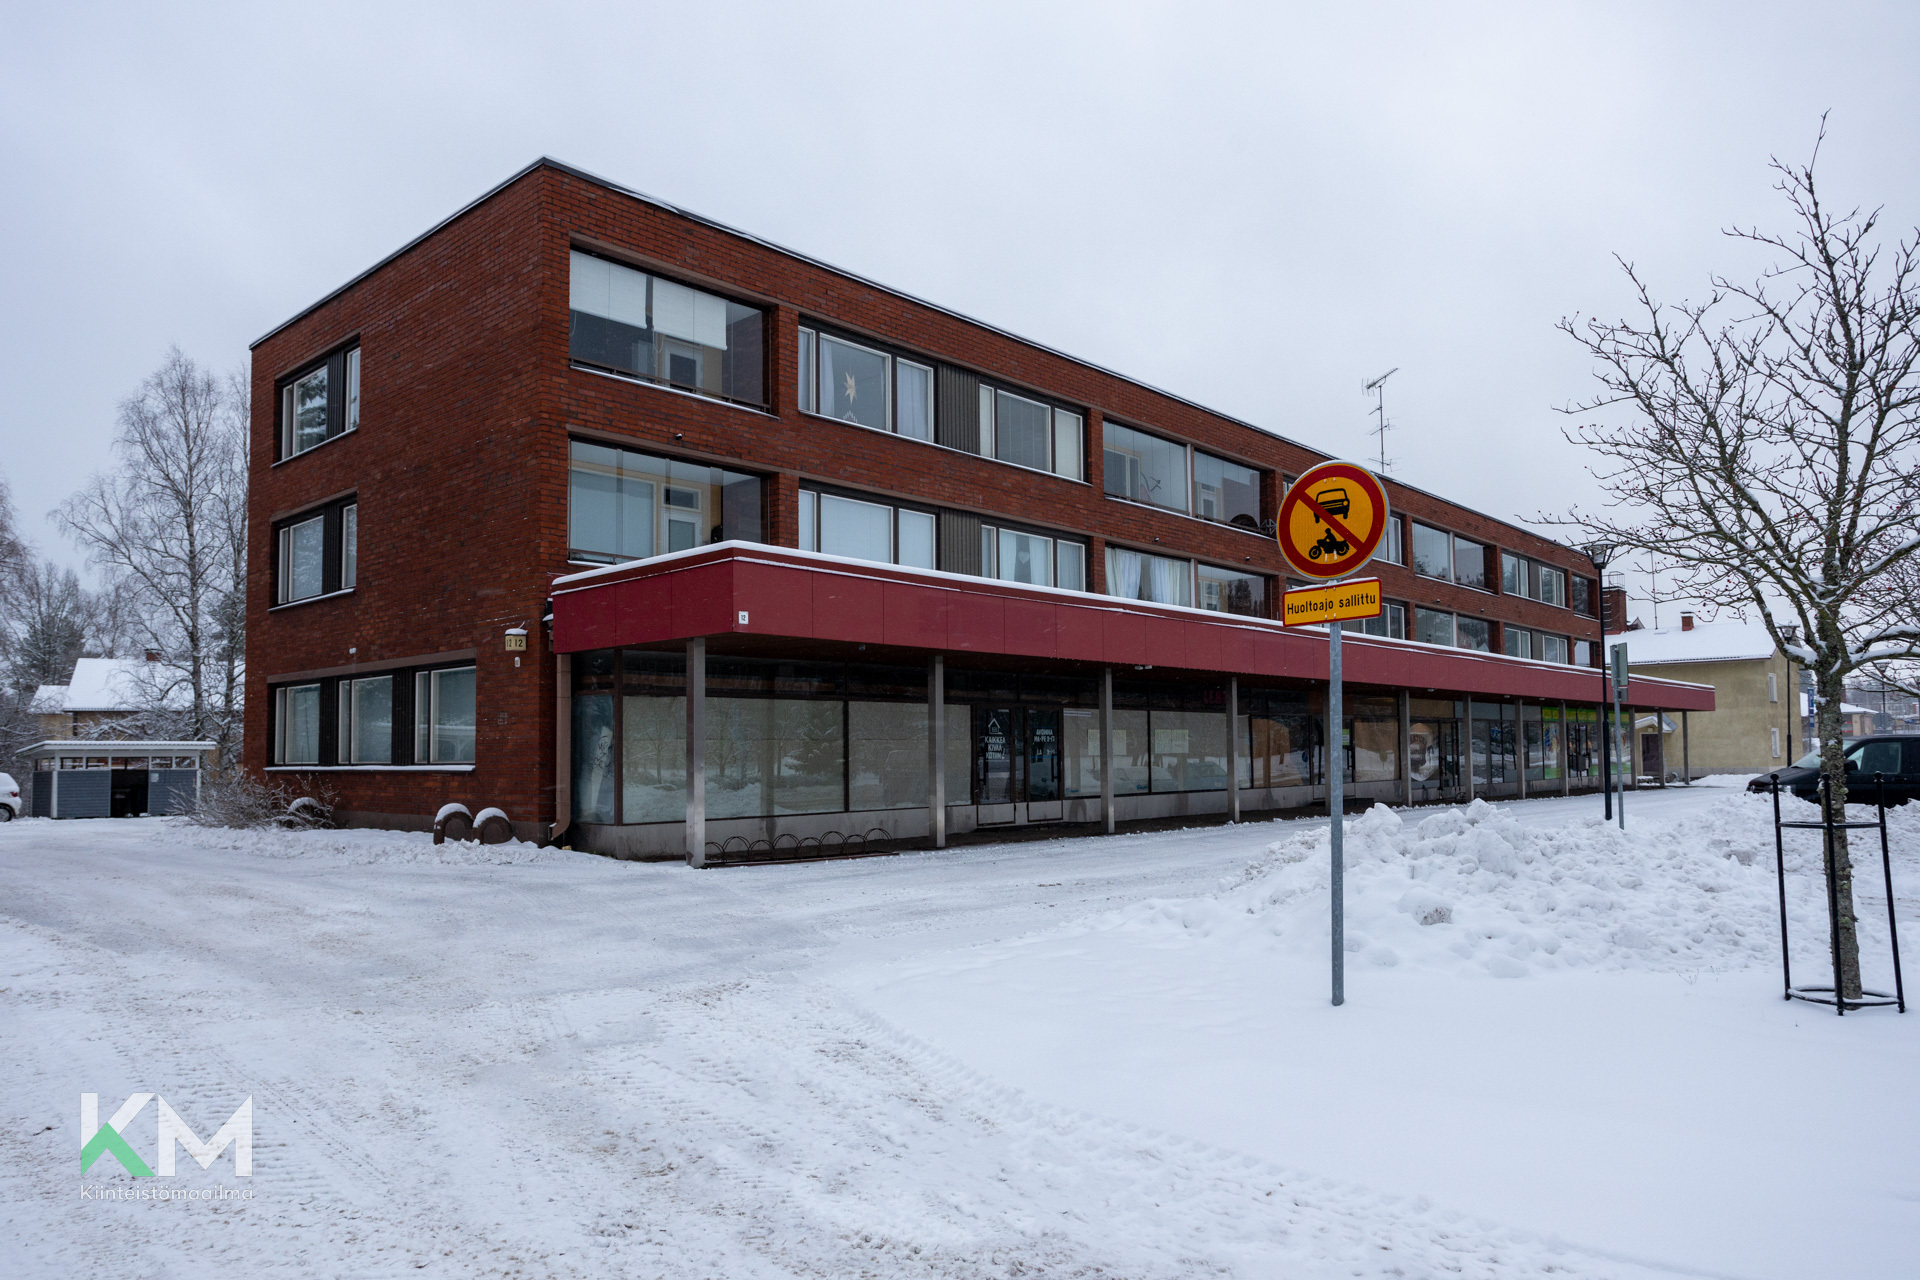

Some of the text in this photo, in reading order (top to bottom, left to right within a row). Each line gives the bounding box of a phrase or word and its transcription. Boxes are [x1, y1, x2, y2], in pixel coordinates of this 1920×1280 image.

[1287, 593, 1377, 615] Huoltoajo sallittu
[741, 614, 747, 622] 12
[514, 638, 523, 648] 12
